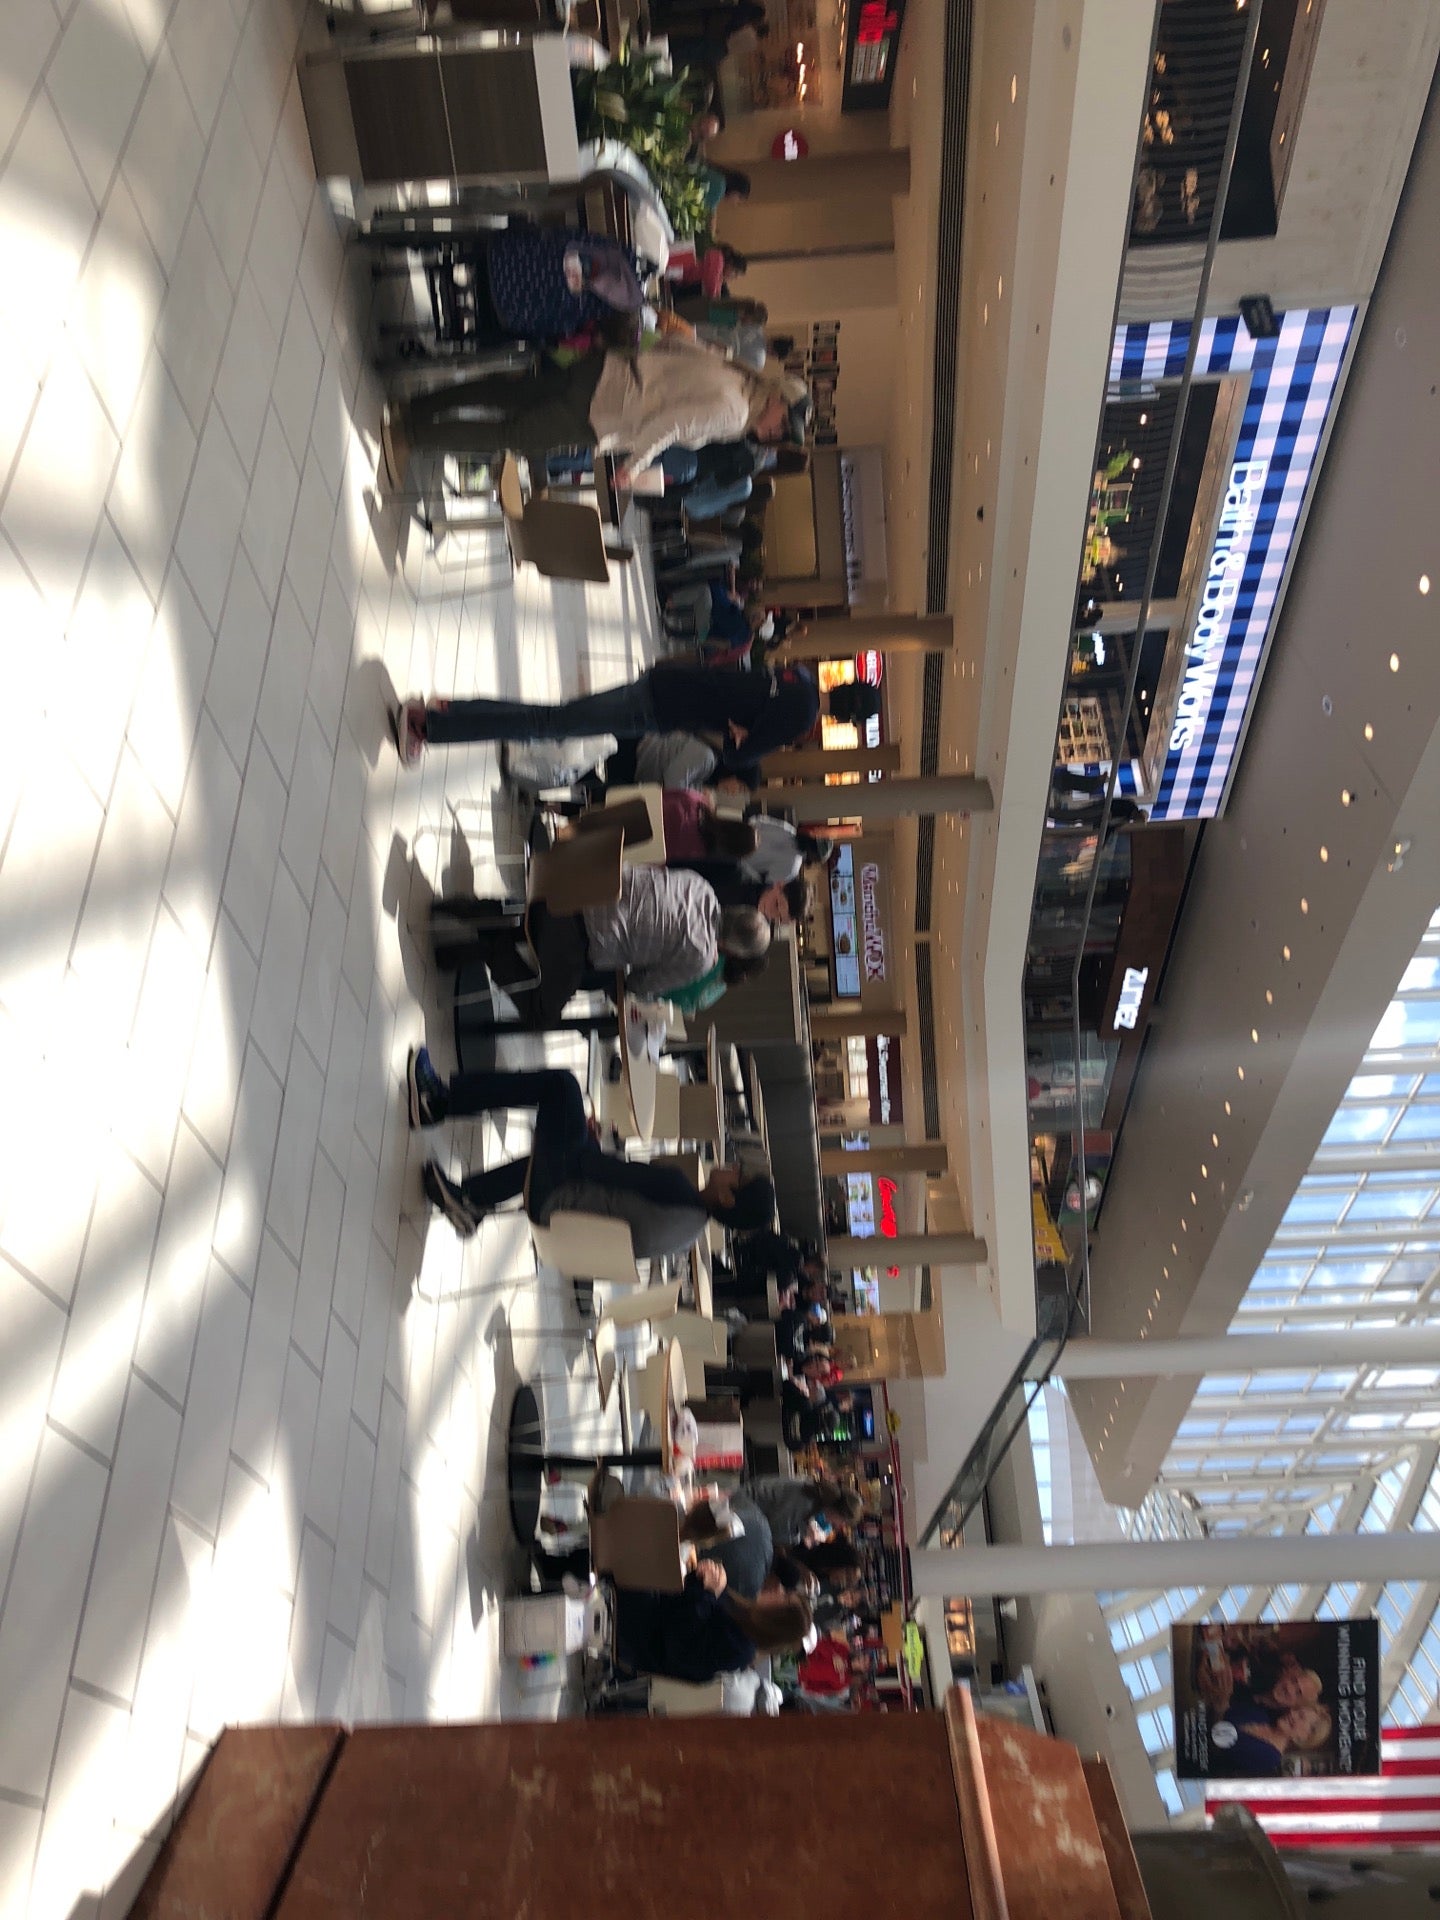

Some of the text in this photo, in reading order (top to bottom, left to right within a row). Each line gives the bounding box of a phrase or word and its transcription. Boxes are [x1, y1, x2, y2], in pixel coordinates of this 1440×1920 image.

[1168, 460, 1268, 751] Bath & Body Works
[1337, 1624, 1351, 1697] WINNING
[1352, 1697, 1367, 1741] YOUR
